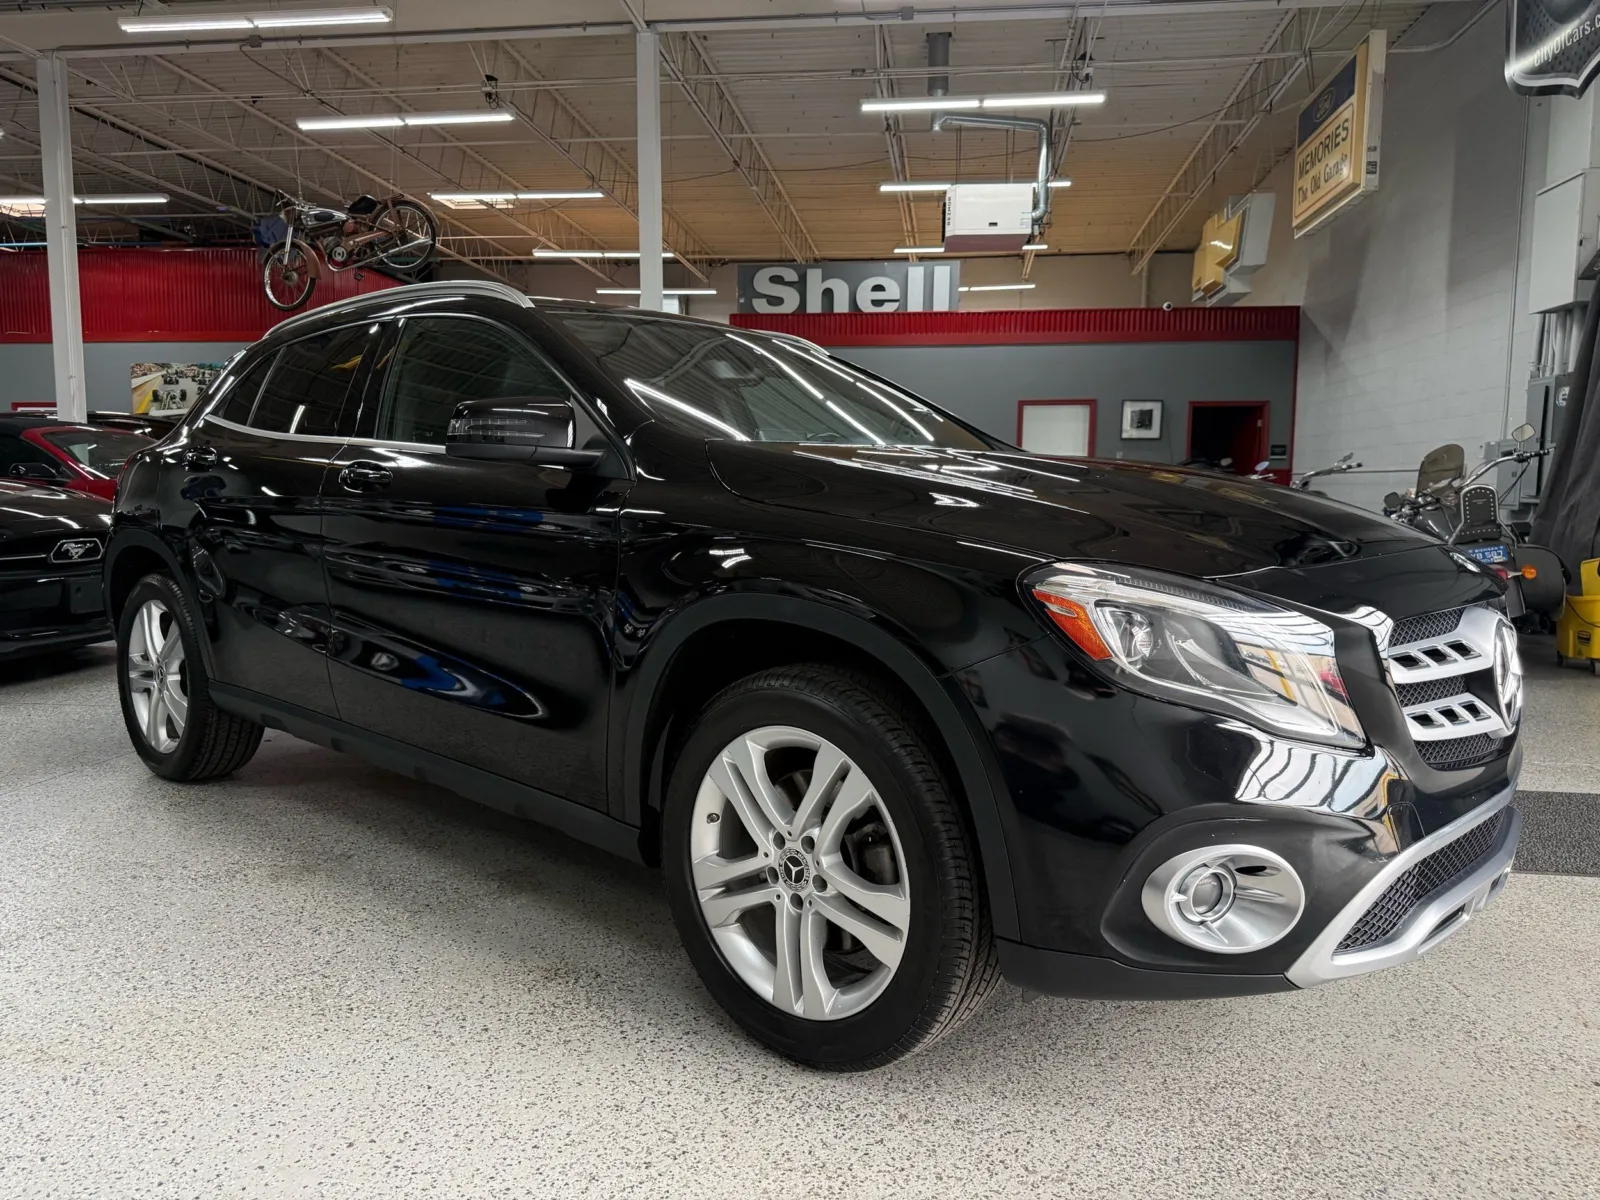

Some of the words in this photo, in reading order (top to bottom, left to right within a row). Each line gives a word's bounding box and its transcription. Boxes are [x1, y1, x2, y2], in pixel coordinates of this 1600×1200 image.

[1298, 118, 1349, 179] MEMORIES
[1298, 186, 1308, 205] The
[1310, 171, 1320, 194] Old
[1324, 152, 1348, 182] Garage
[751, 265, 950, 314] Shell
